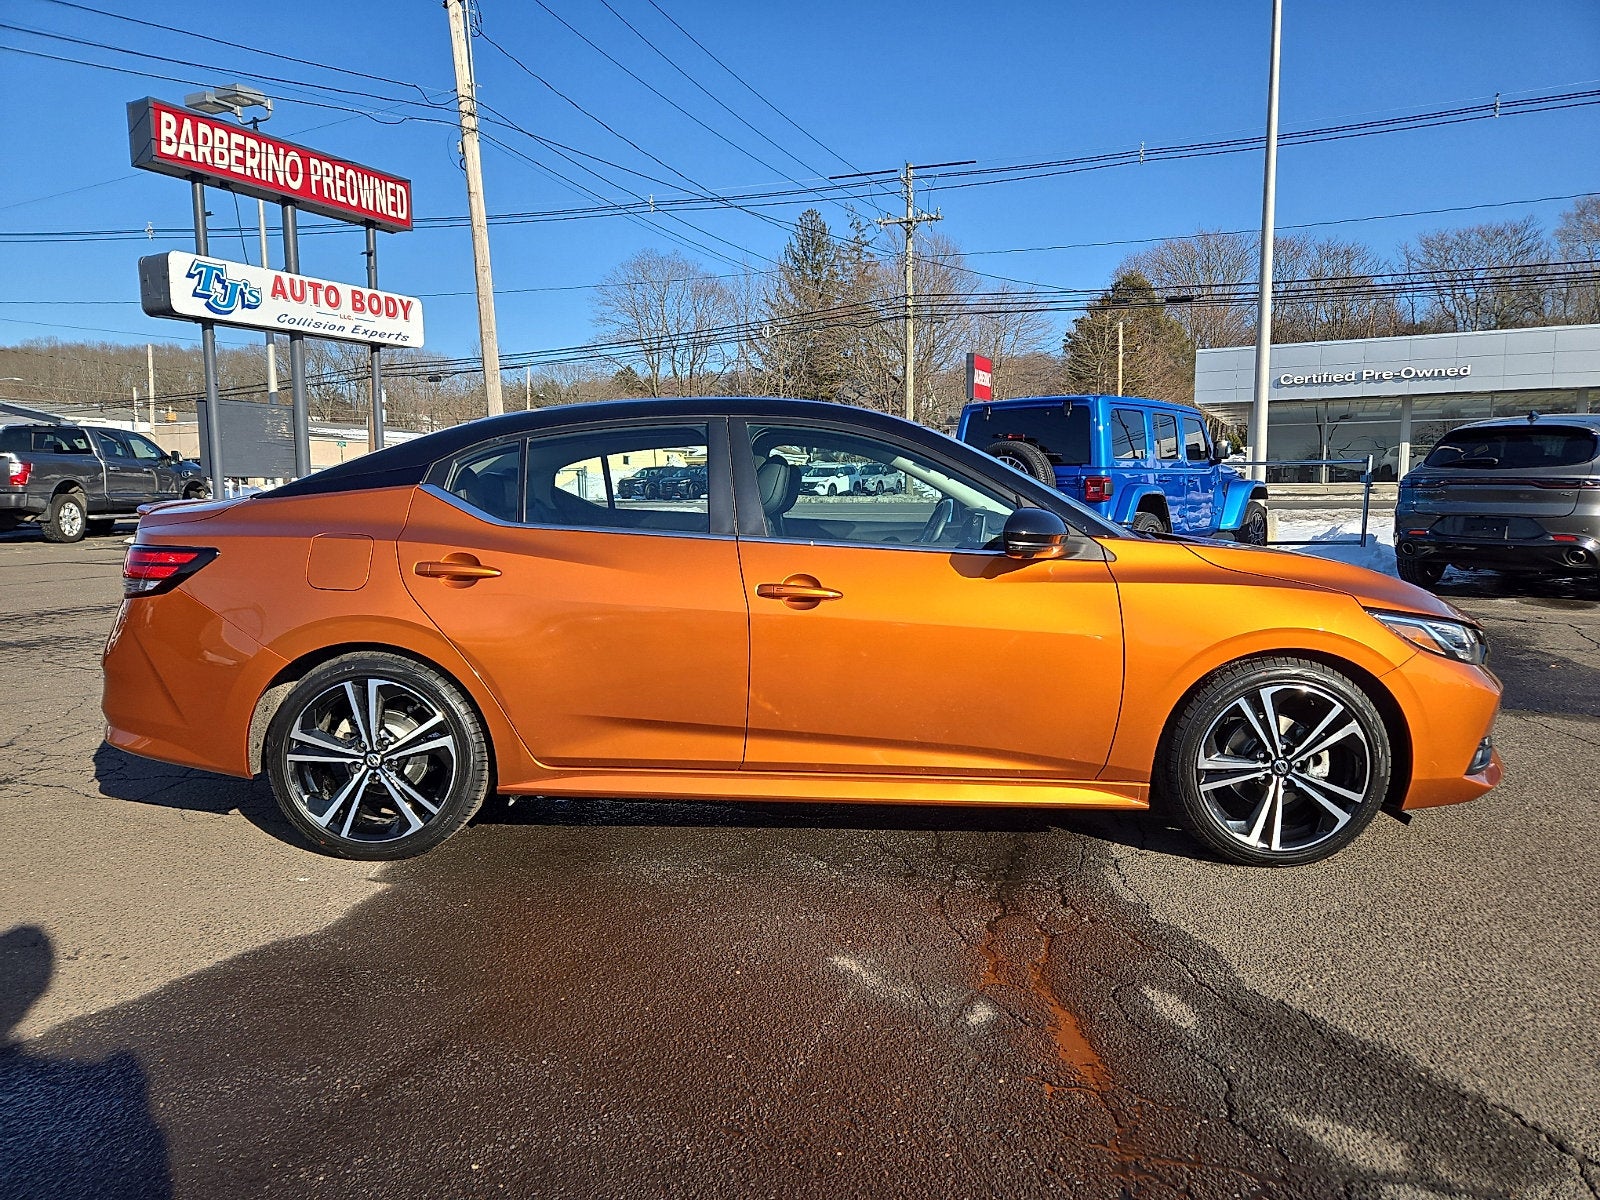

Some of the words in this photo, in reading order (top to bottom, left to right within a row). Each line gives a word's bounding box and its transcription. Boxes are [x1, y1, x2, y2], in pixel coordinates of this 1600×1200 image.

[160, 111, 304, 190] BARBERINO
[309, 158, 408, 220] PREOWNED
[271, 275, 341, 310] AUTO
[351, 289, 412, 321] BODY
[277, 313, 345, 332] Collision
[351, 325, 410, 342] Experts
[1280, 371, 1356, 385] Certified
[1362, 365, 1472, 380] Pre-Owned
